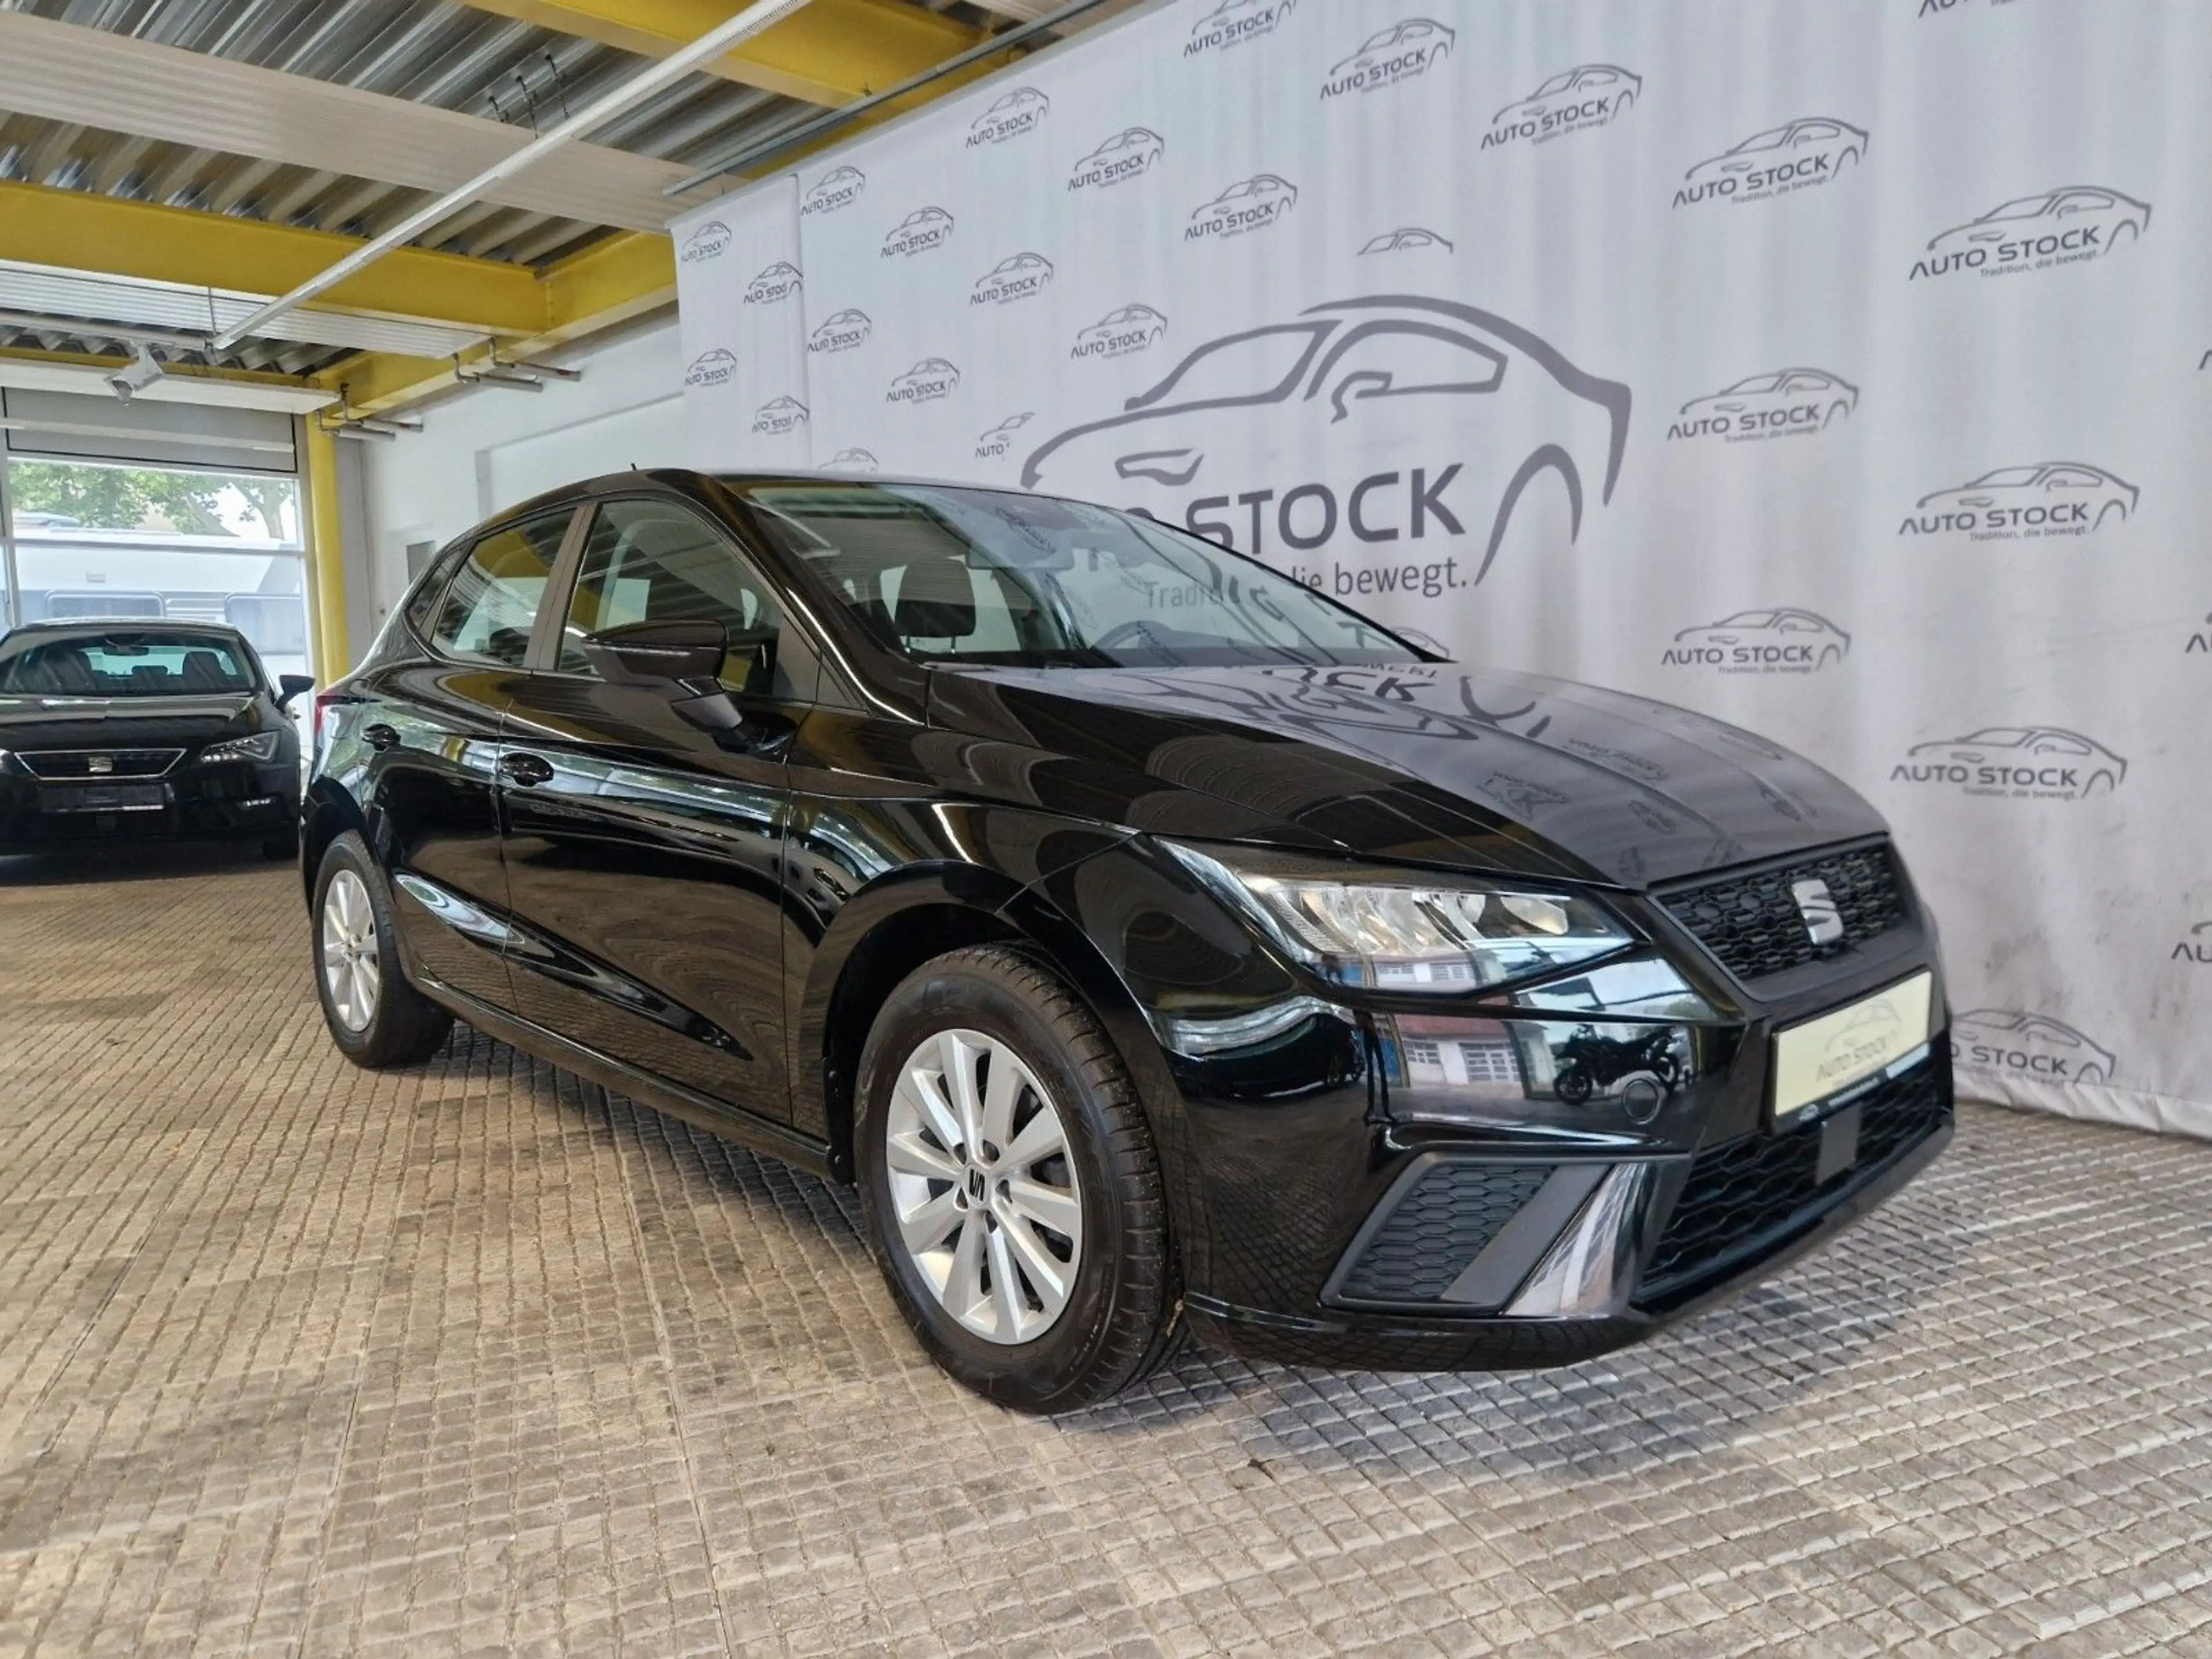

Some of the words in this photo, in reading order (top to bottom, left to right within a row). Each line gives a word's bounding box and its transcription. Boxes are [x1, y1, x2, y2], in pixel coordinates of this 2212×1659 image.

[1183, 32, 1221, 58] AUTO
[1225, 7, 1274, 39] STOCK
[1320, 71, 1365, 100] AUTO
[1369, 48, 1426, 81] STOCK
[965, 127, 994, 149] AUTO
[997, 111, 1033, 135] STOCK
[1480, 121, 1536, 150] AUTO
[1541, 97, 1609, 132] STOCK
[1067, 170, 1101, 192] AUTO
[1104, 153, 1145, 179] STOCK
[1672, 177, 1737, 210] AUTO
[1747, 153, 1829, 191] STOCK
[800, 198, 823, 216] AUTO
[826, 187, 853, 206] STOCK
[1184, 218, 1223, 241] AUTO
[1226, 202, 1274, 230] STOCK
[881, 241, 907, 258] AUTO
[909, 228, 940, 248] STOCK
[1908, 248, 1986, 281] AUTO
[1997, 225, 2101, 263] STOCK
[970, 288, 999, 306] AUTO
[1001, 276, 1037, 297] STOCK
[808, 338, 828, 353] AUTO
[831, 331, 861, 346] STOCK
[1071, 340, 1105, 359] AUTO
[1108, 329, 1146, 350] STOCK
[886, 387, 915, 403] AUTO
[915, 380, 946, 396] STOCK
[1666, 416, 1730, 441] AUTO
[1739, 404, 1821, 431] STOCK
[975, 442, 1005, 459] AUTO
[1185, 463, 1466, 556] STOCK
[1898, 512, 1976, 536] AUTO
[1986, 502, 2090, 529] STOCK
[1335, 556, 1467, 599] bewegt.
[1661, 647, 1724, 665] AUTO
[1732, 645, 1814, 664] STOCK
[1889, 764, 1968, 783] AUTO
[1977, 766, 2078, 787] STOCK
[1971, 1044, 2068, 1077] STOCK
